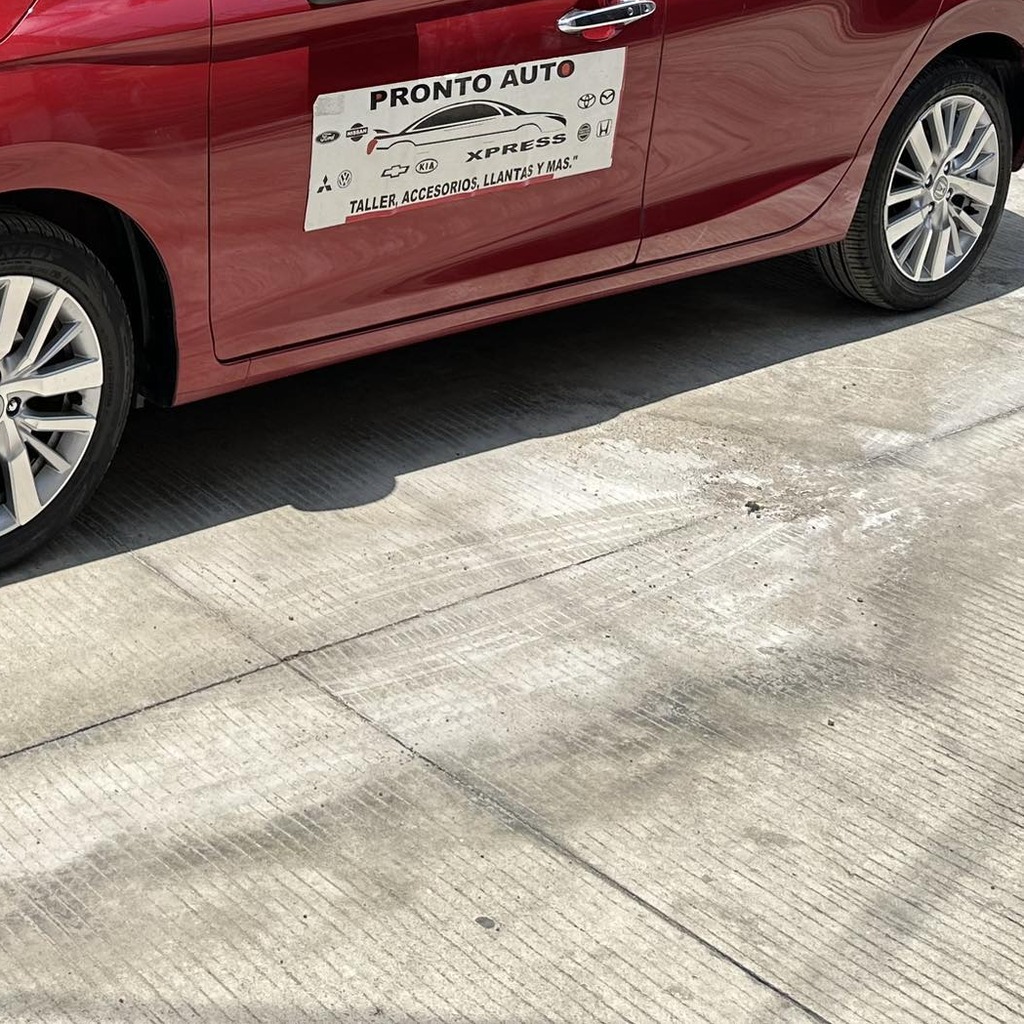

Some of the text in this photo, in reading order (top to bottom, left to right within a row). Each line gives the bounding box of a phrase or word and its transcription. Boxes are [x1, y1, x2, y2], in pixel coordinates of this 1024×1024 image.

[370, 60, 575, 110] PRONTO AUTO
[346, 127, 368, 138] NISSAN
[465, 133, 566, 162] XPRESS
[419, 161, 434, 172] KIA
[350, 193, 397, 214] TALLER,
[483, 164, 533, 186] LLANTAS
[537, 161, 544, 174] Y
